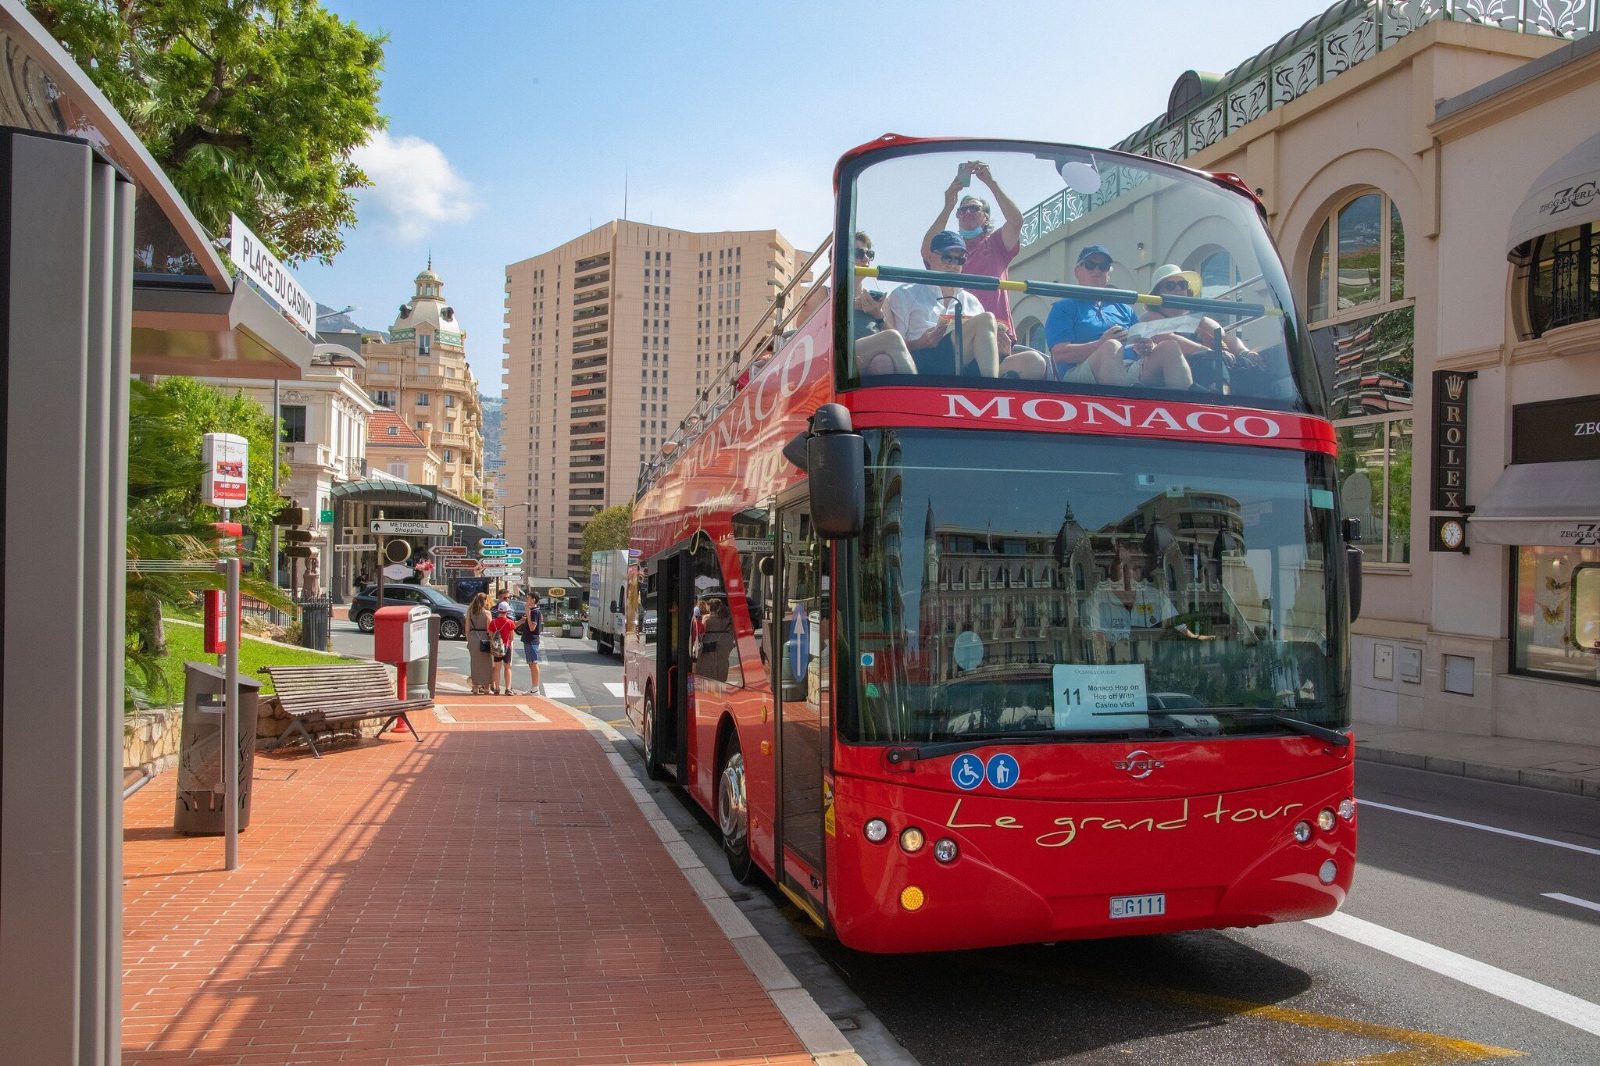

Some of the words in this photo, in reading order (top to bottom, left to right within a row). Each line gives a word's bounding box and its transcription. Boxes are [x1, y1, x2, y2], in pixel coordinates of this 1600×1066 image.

[243, 235, 274, 288] PLACE
[275, 268, 286, 300] DU
[287, 282, 312, 326] CASINO
[941, 394, 1280, 438] MONACO
[1445, 406, 1462, 508] ROLEX
[1560, 530, 1584, 538] ZEGG
[1584, 530, 1592, 538] &
[1063, 688, 1081, 706] 11
[1120, 700, 1135, 708] Visit
[946, 798, 1024, 828] Le
[1035, 798, 1188, 847] grand
[1203, 795, 1304, 824] tour
[1125, 896, 1162, 914] G111
